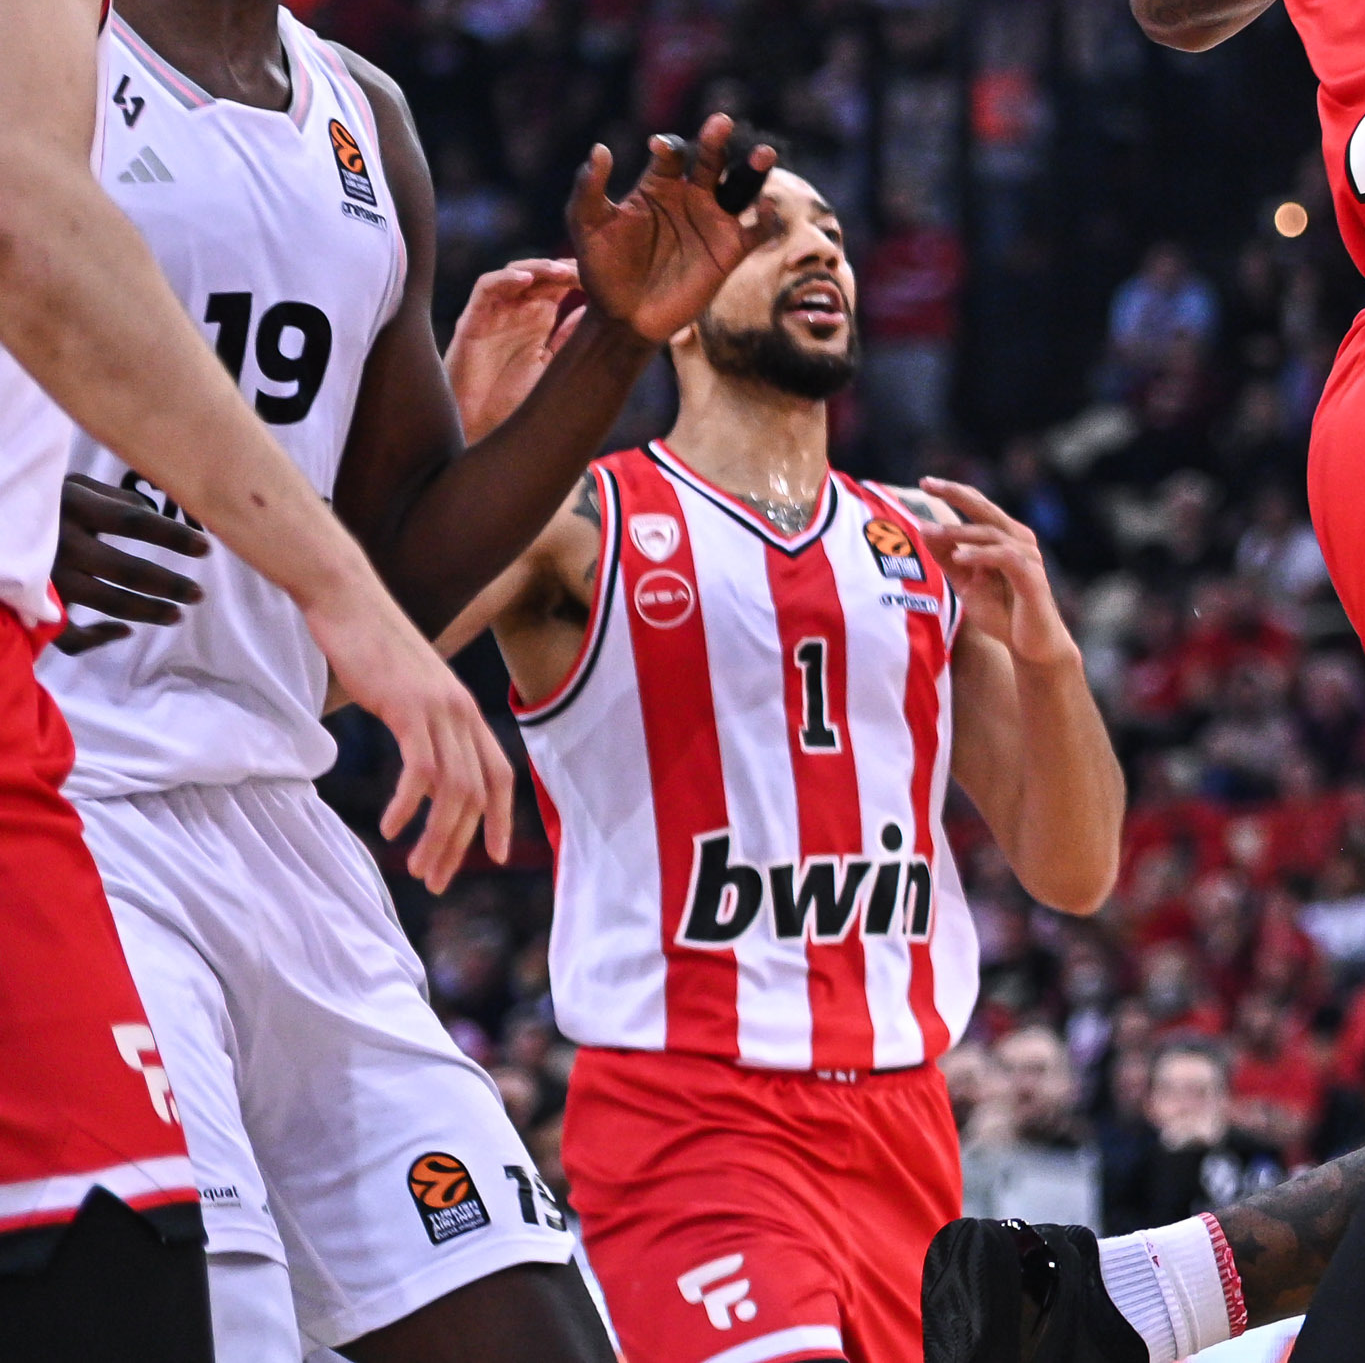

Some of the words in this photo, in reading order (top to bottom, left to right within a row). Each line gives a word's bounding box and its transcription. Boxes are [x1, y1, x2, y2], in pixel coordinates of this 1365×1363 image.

[203, 291, 332, 425] 19
[796, 638, 841, 754] 1
[676, 821, 934, 948] bwin
